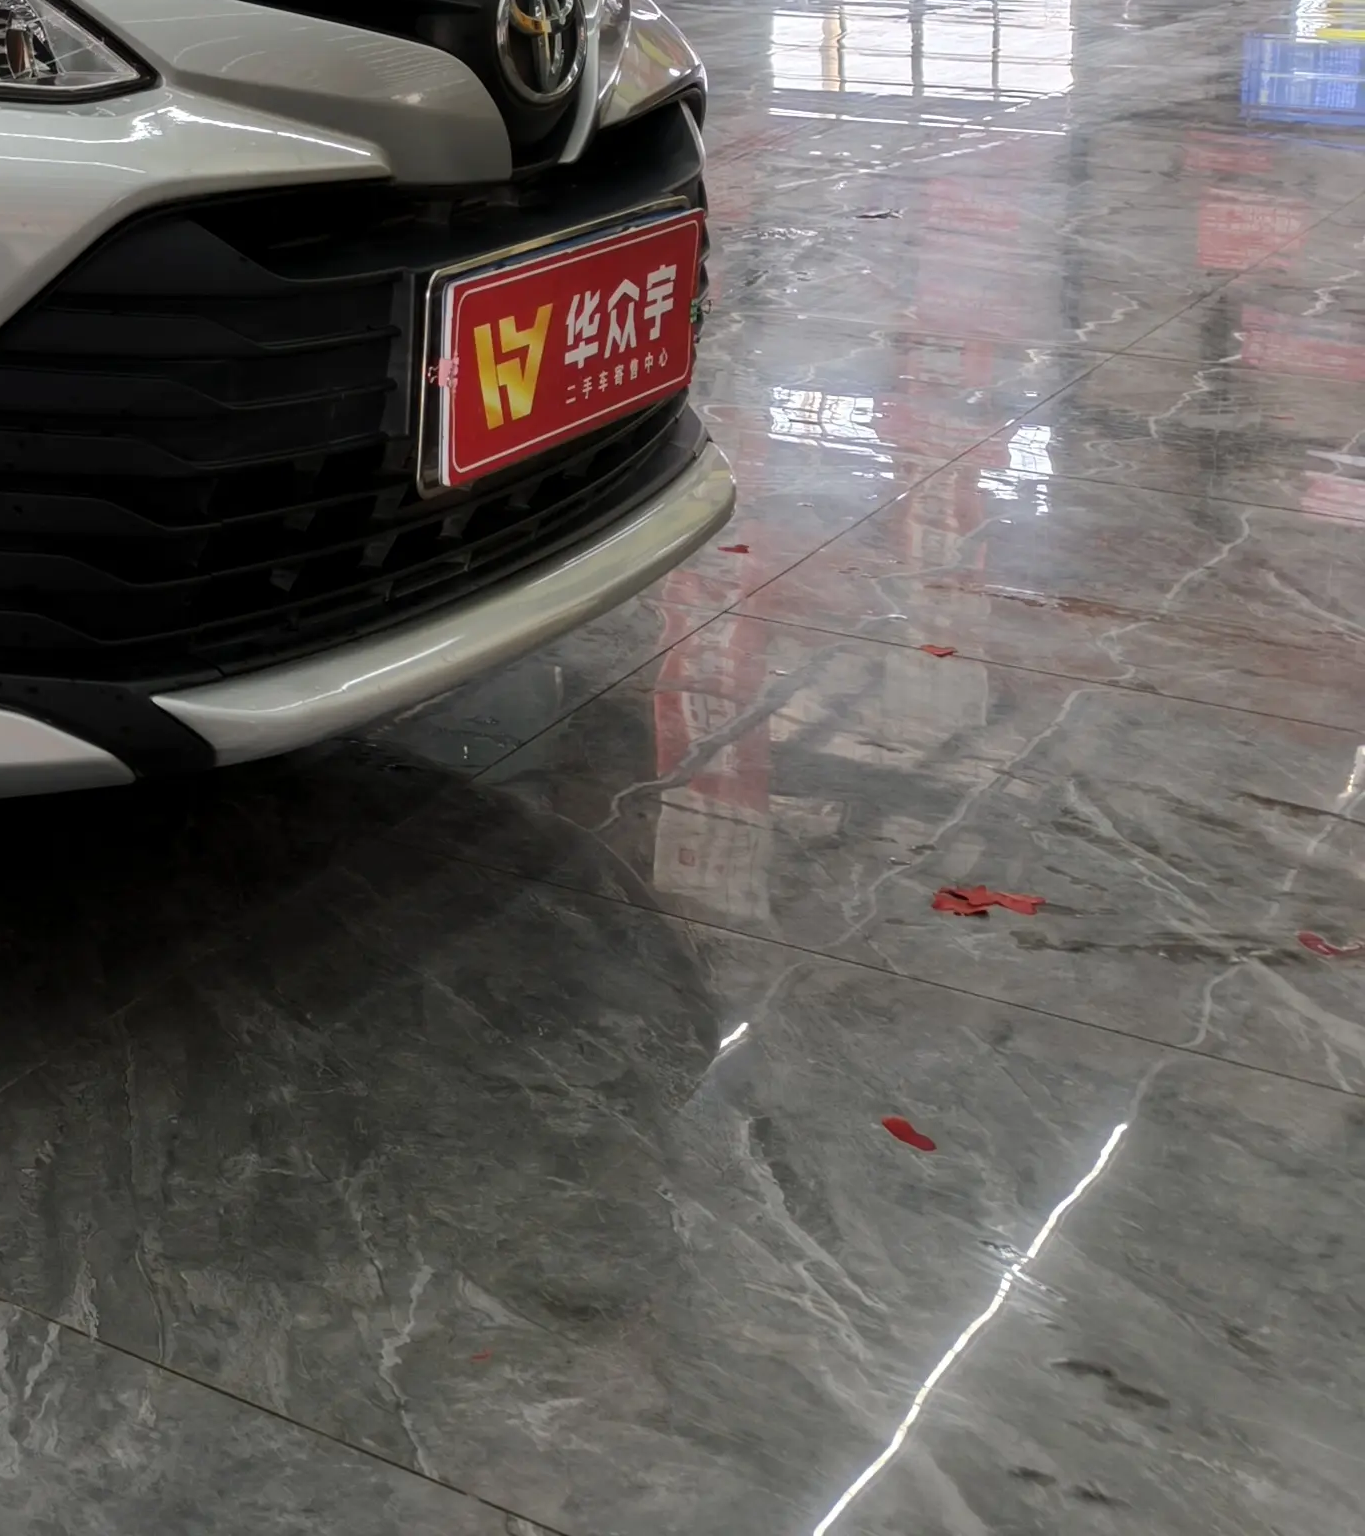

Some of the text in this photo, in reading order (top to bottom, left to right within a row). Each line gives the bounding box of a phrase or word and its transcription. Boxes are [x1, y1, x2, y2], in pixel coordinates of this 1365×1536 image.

[564, 264, 678, 369] 华众宇
[565, 347, 669, 405] 二手车寄售中心
